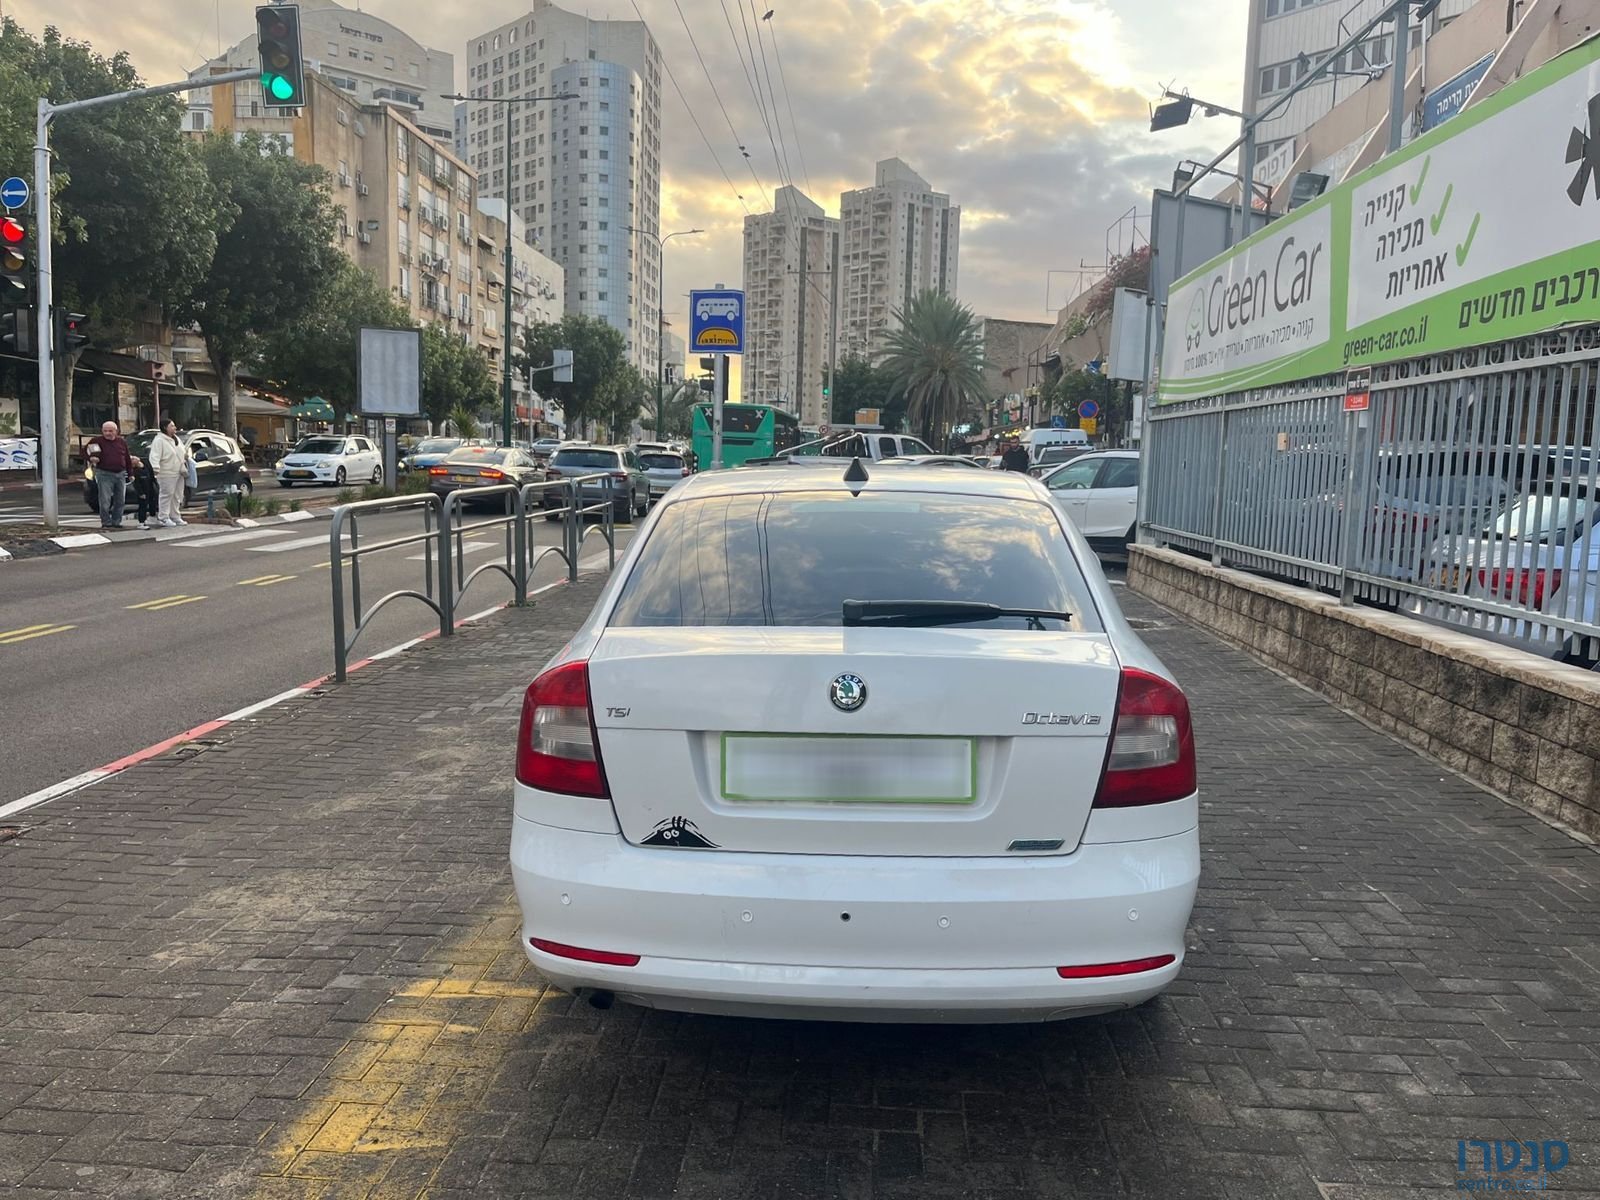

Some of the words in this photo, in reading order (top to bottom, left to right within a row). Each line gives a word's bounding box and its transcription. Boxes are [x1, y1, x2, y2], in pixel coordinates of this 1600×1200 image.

[1436, 88, 1463, 115] קדימה
[1258, 149, 1288, 184] דפוס
[1364, 183, 1406, 227] קנייה
[1375, 217, 1424, 262] מכירה
[1207, 275, 1267, 337] Green
[1273, 236, 1322, 312] Car
[1385, 251, 1448, 300] אחריות
[1531, 267, 1600, 313] רכבים
[1459, 286, 1526, 329] חדשים
[1270, 324, 1291, 346] מכירה
[1343, 314, 1428, 365] green-car.co.il
[1021, 711, 1102, 726] Octavia
